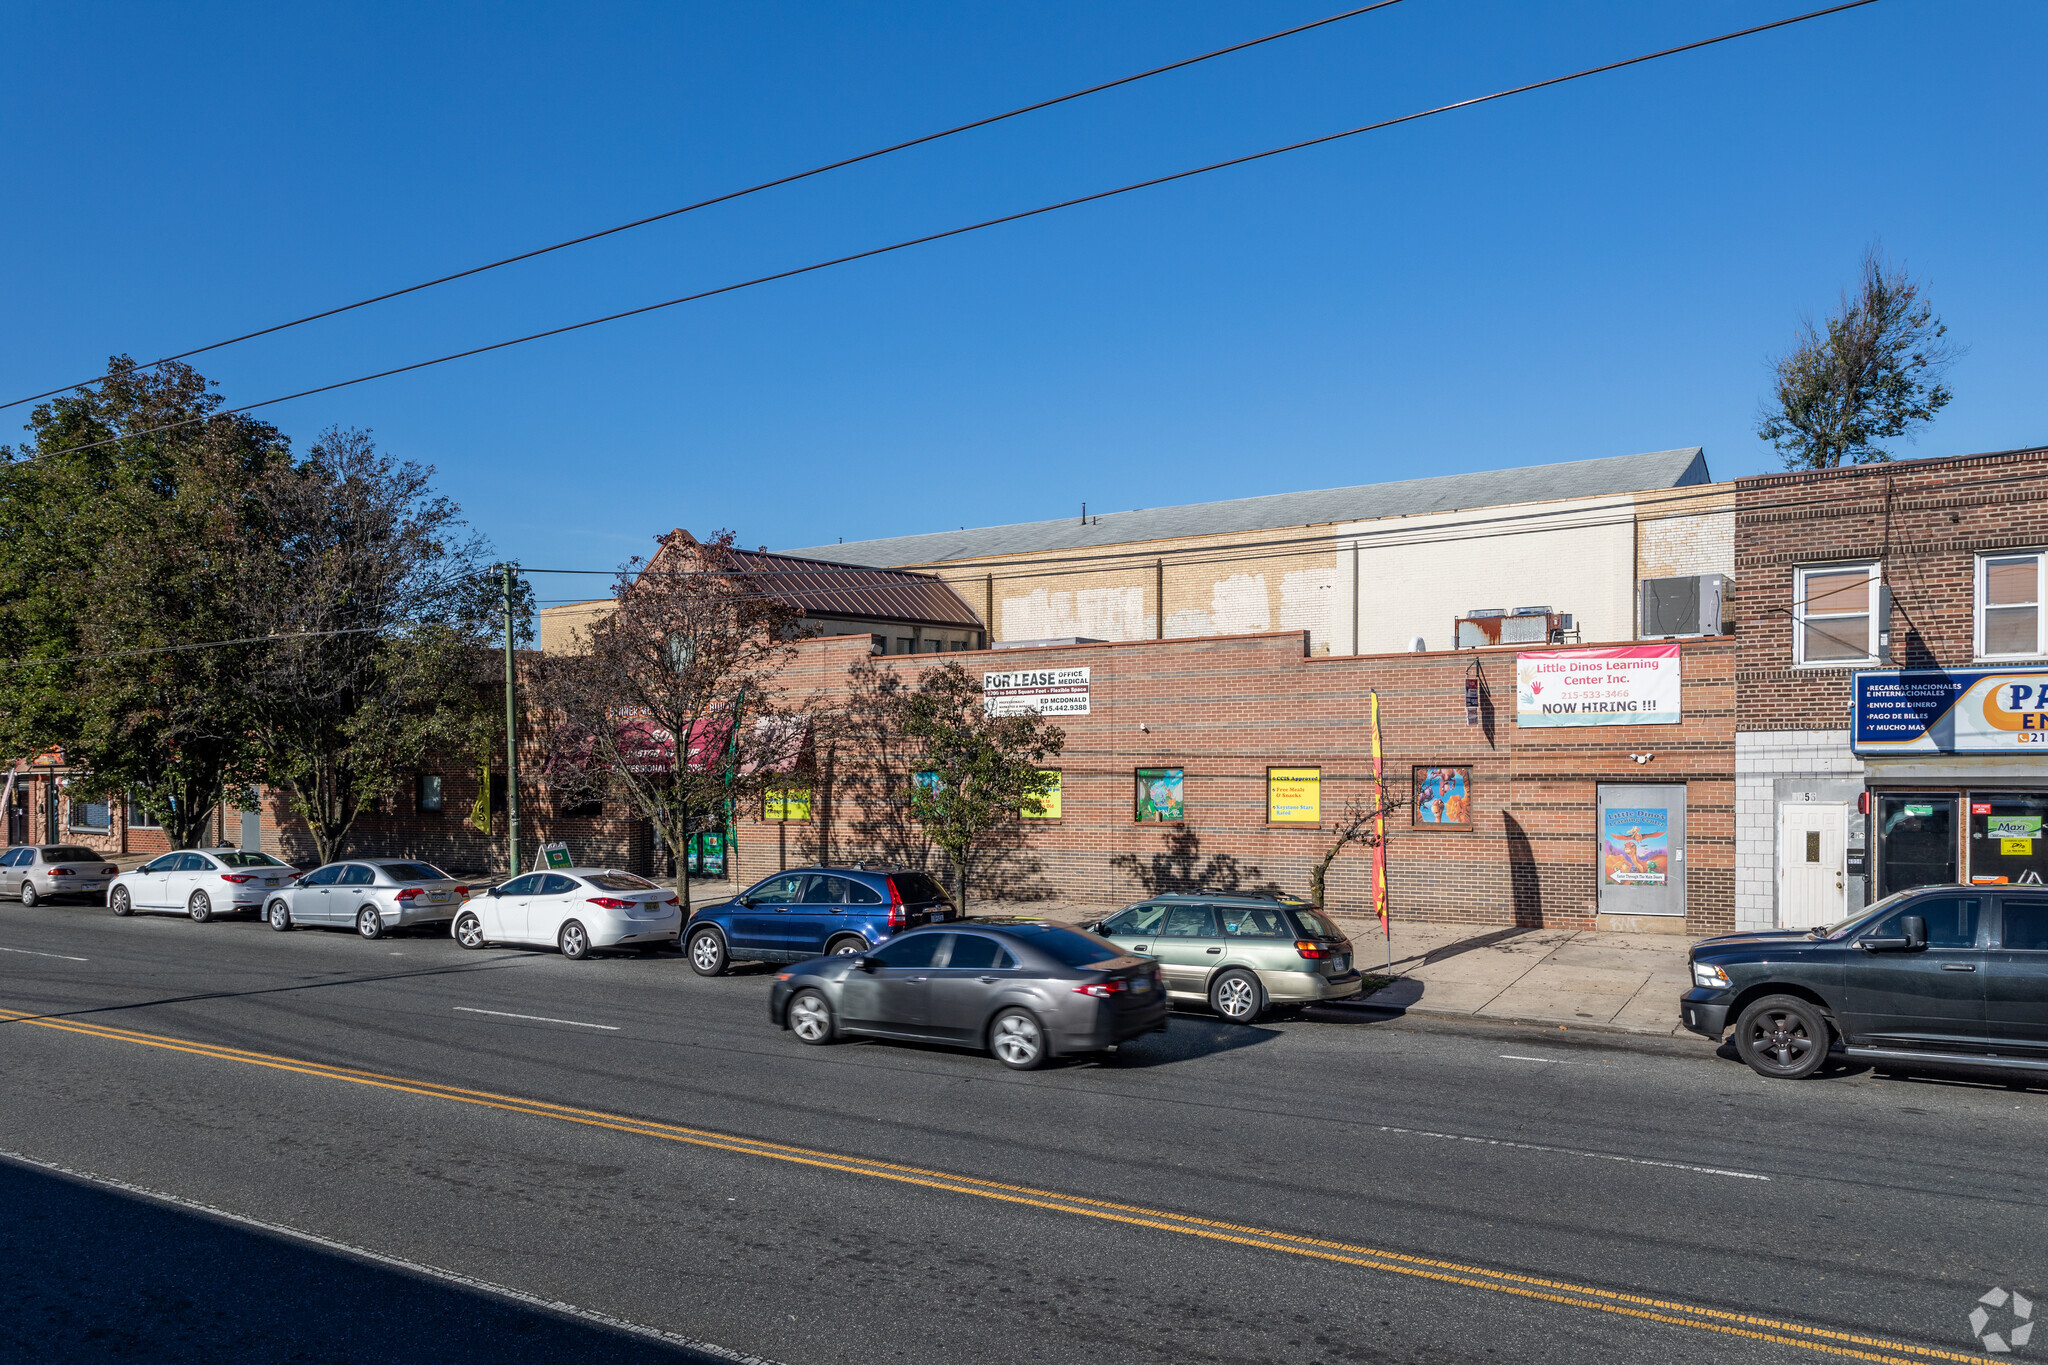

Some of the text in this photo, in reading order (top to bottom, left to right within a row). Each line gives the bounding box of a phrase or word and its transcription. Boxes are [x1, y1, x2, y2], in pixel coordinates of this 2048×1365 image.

[1537, 659, 1658, 673] Little Dinos Learning
[985, 672, 1056, 688] FOR LEASE
[1564, 674, 1630, 686] Center Inc.
[1562, 690, 1629, 700] 215-533-3466
[1040, 704, 1088, 712] 215.442.9388
[1542, 700, 1656, 714] NOW HIRING !!!
[1608, 810, 1665, 820] Little Dino's
[1609, 818, 1665, 826] Learning Center
[1998, 822, 2025, 831] Maxi
